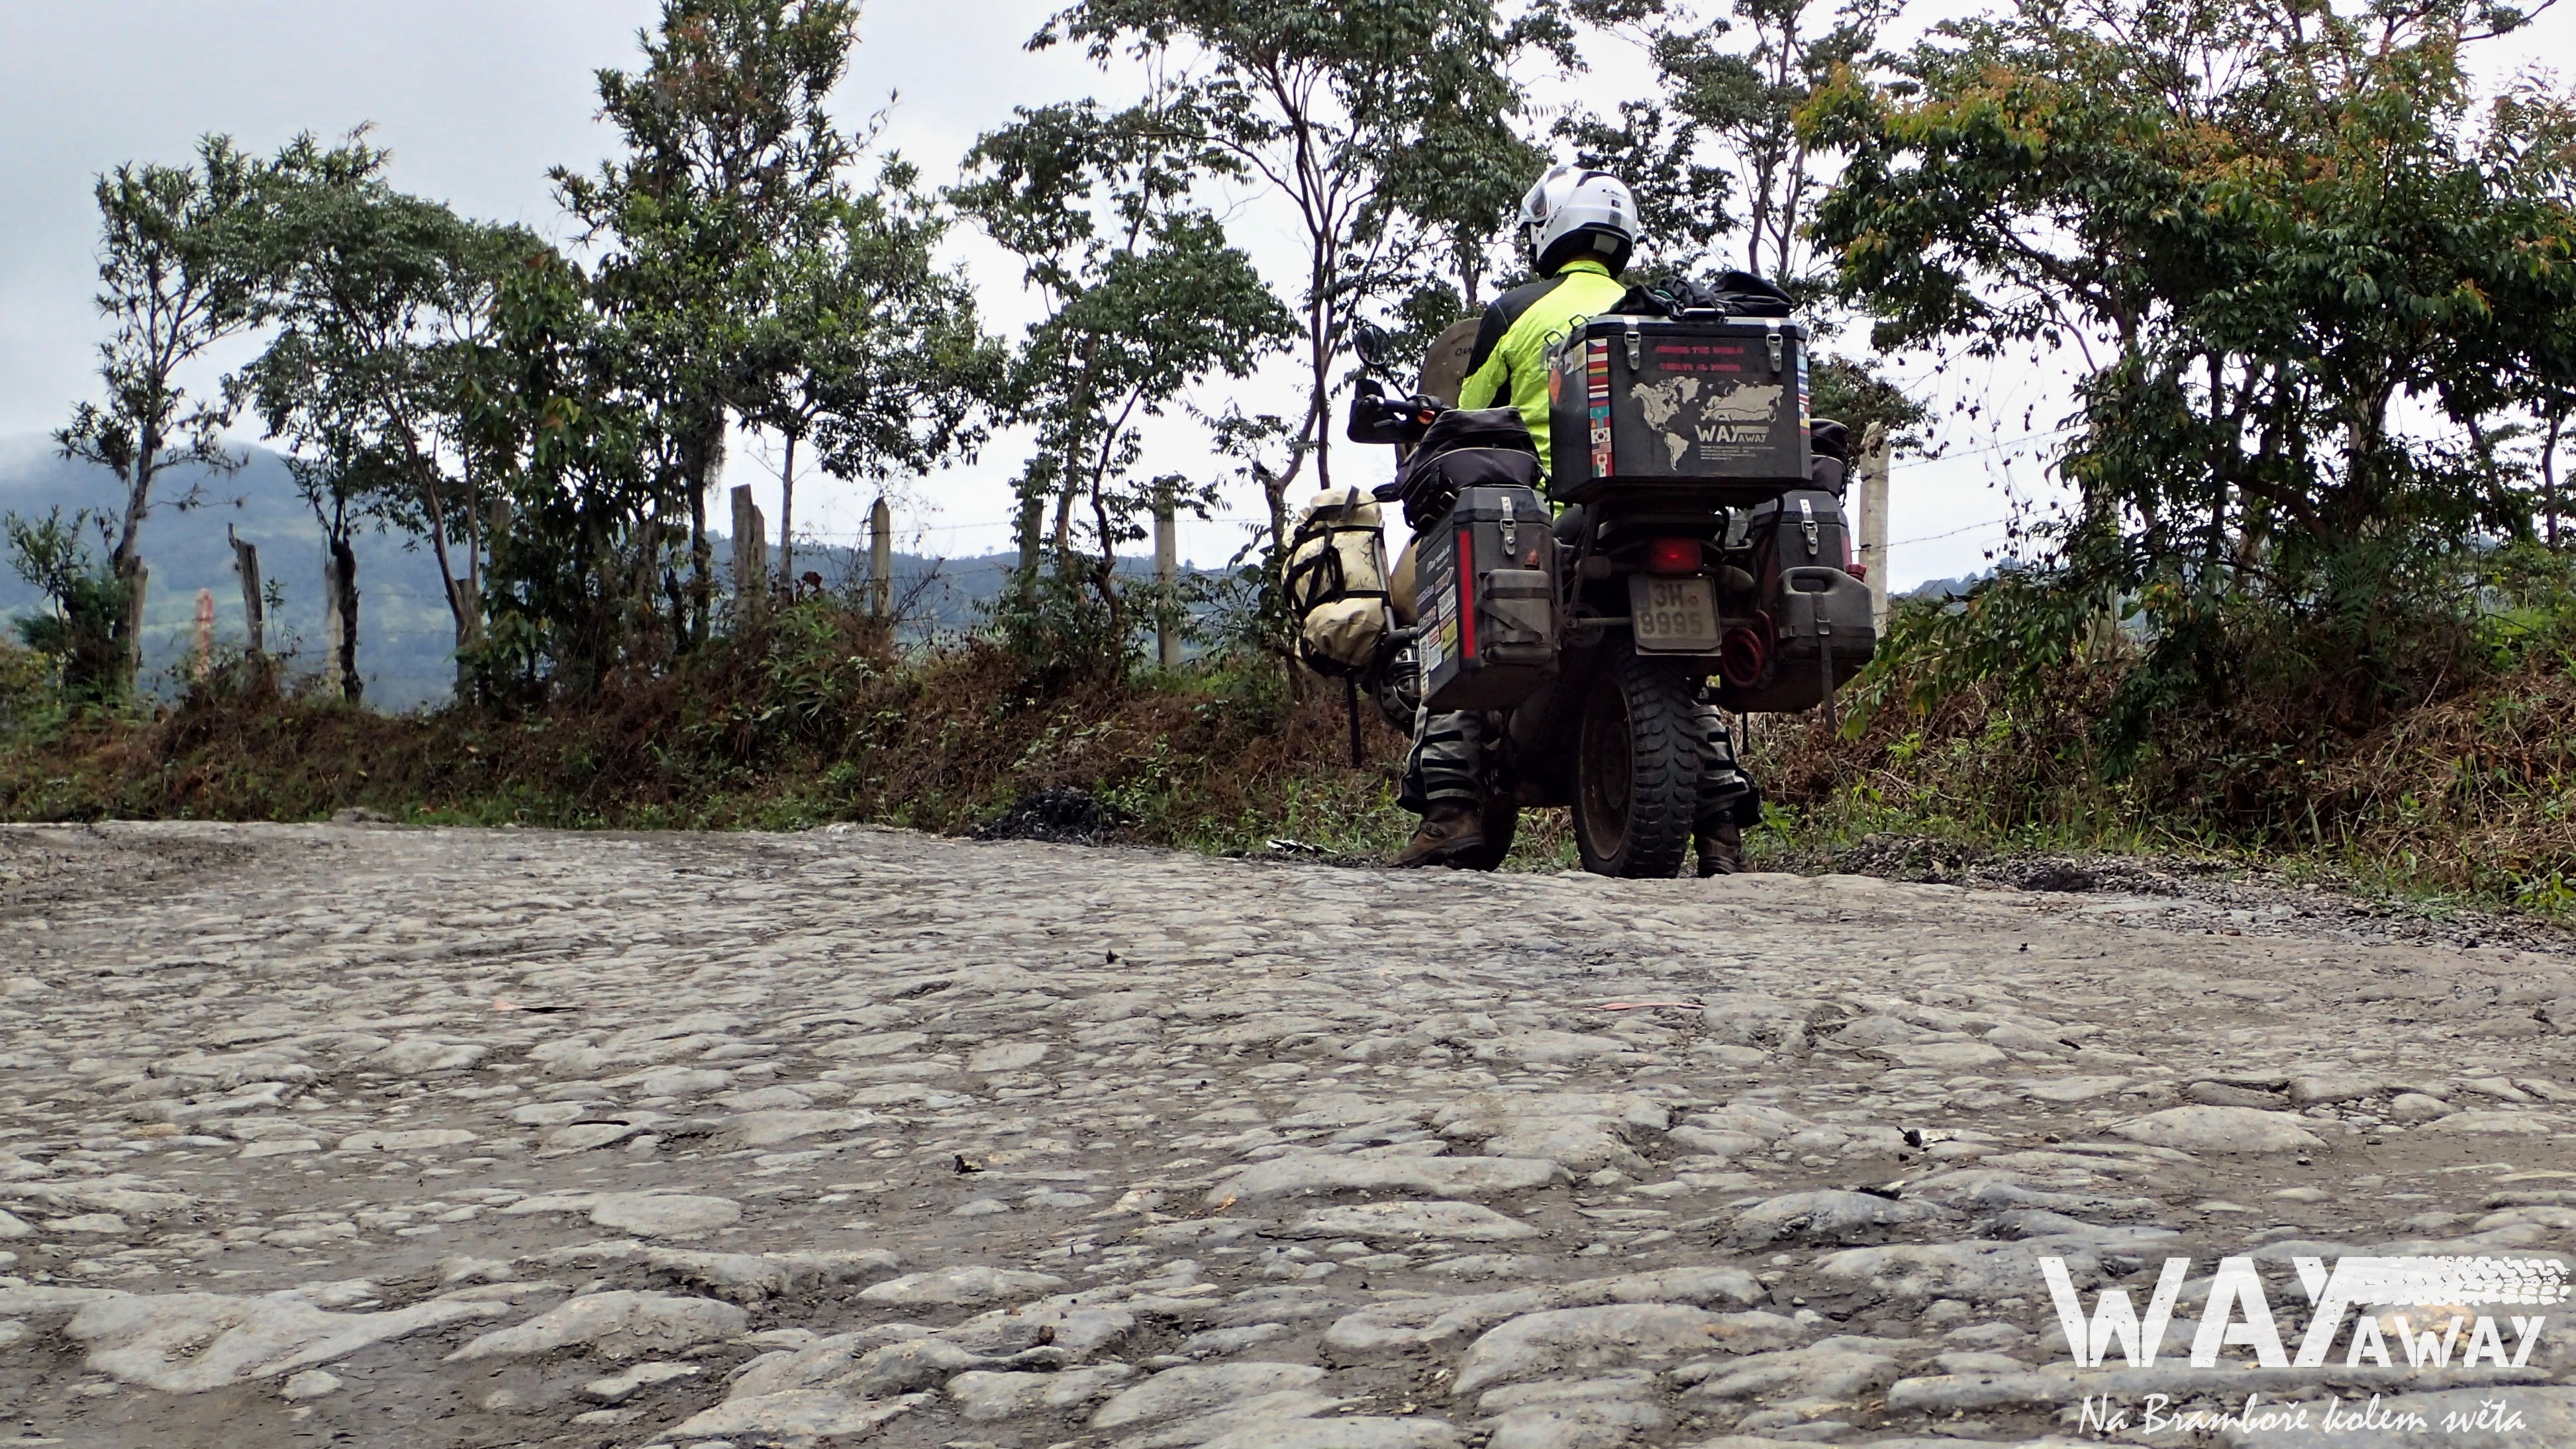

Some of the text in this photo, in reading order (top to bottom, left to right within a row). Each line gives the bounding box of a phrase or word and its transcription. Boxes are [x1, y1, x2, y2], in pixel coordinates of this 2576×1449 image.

[1695, 425, 1738, 442] WAY
[1657, 584, 1684, 607] 3H
[1642, 613, 1702, 636] 9995
